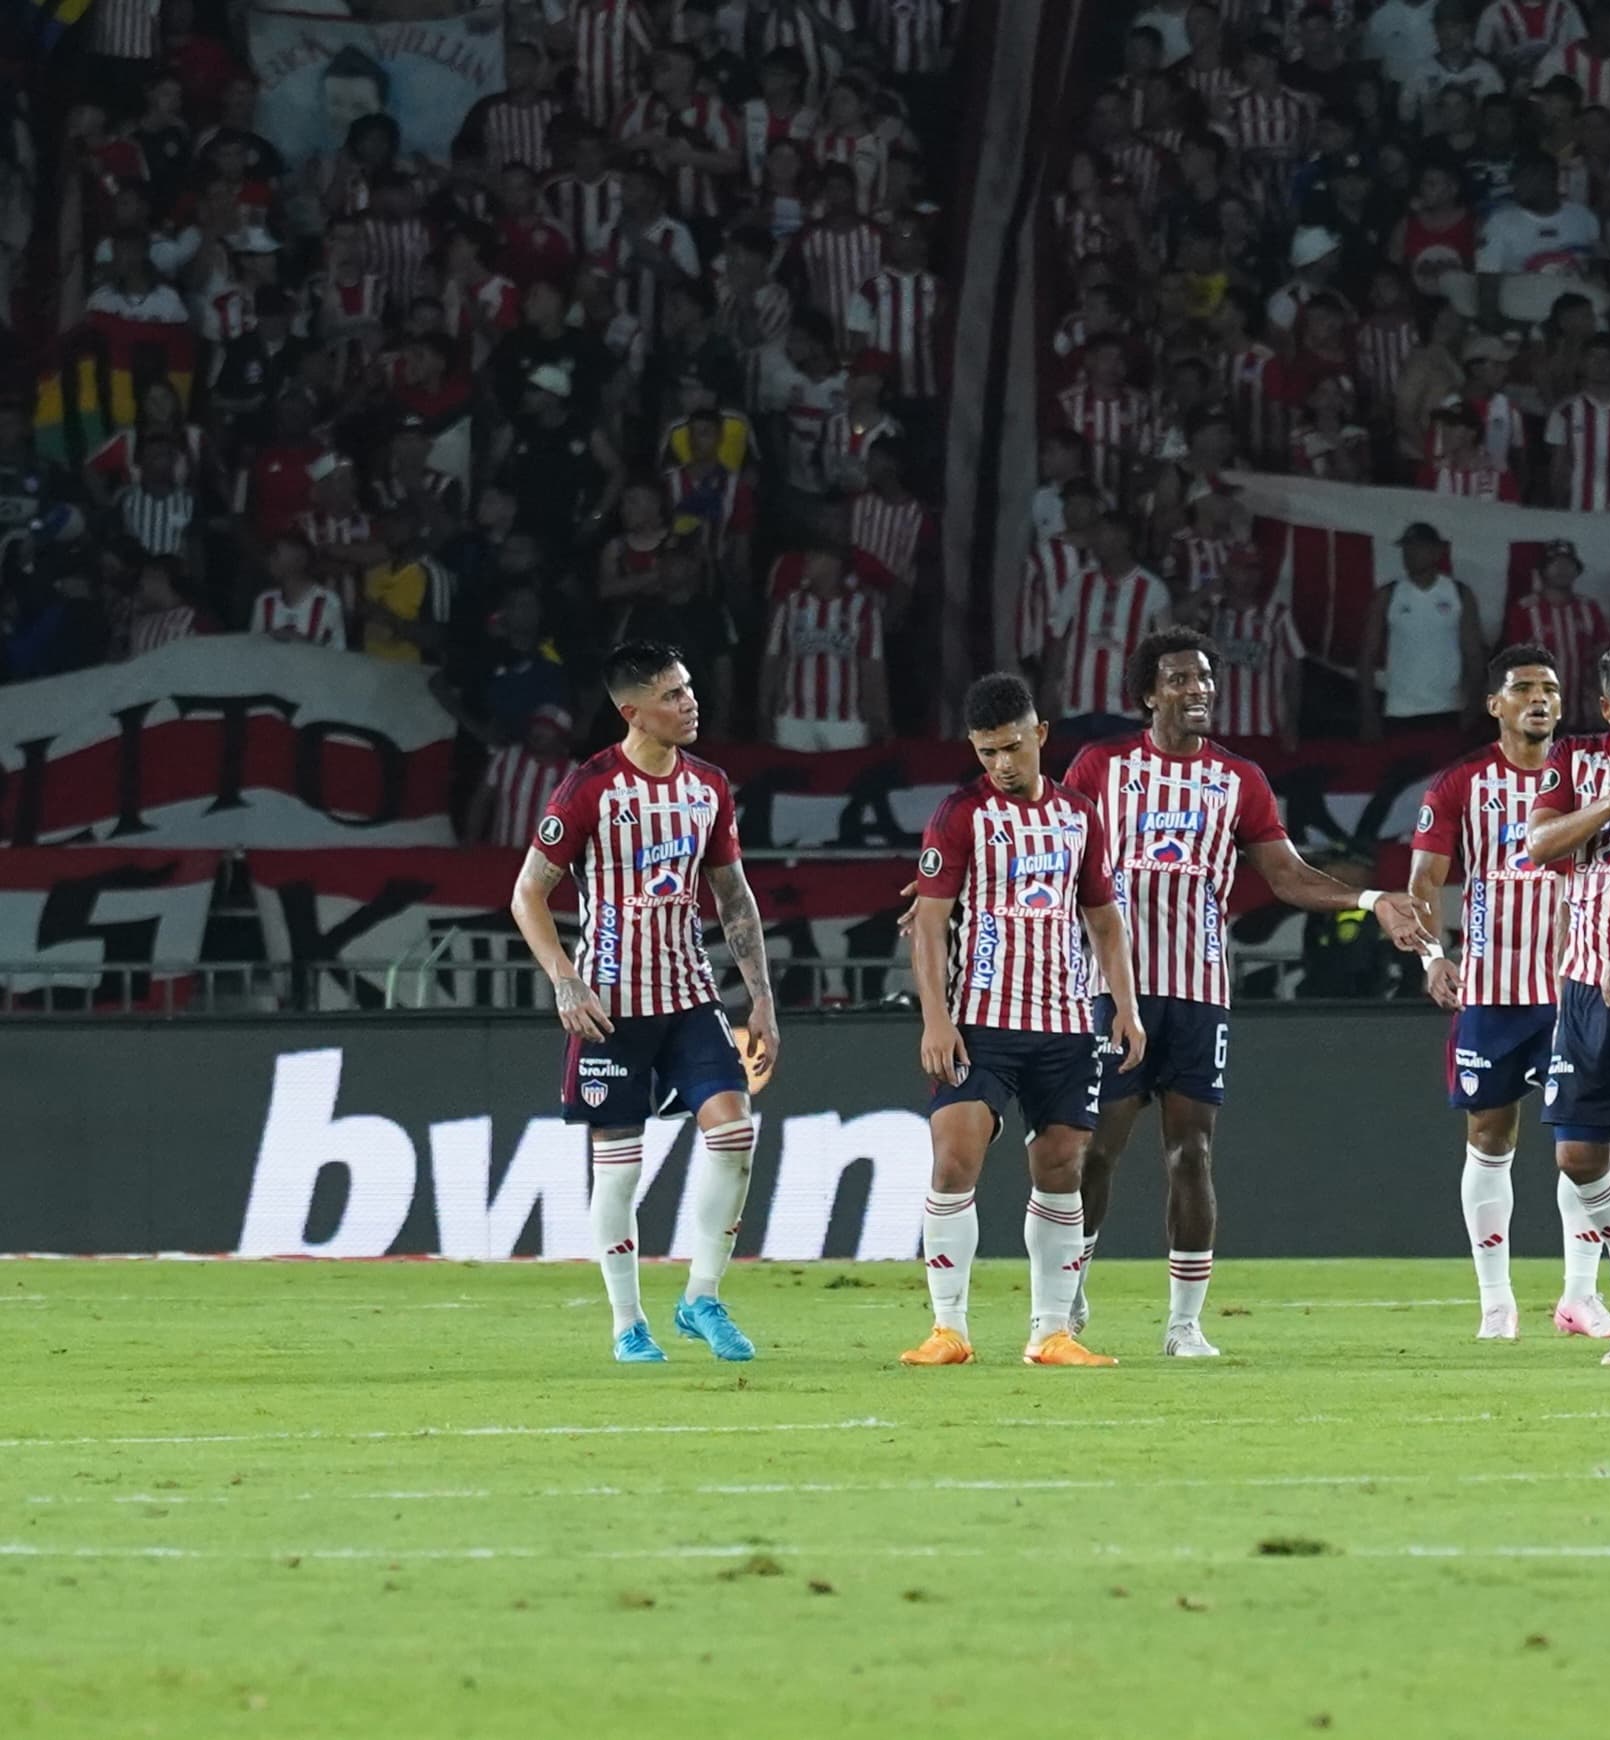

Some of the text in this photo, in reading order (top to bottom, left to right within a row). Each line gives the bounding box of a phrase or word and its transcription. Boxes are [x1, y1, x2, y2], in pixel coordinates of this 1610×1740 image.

[0, 692, 417, 848] LITO
[1144, 813, 1198, 830] AGUILA
[640, 837, 692, 868] AGUILA
[1014, 853, 1064, 877] AGUILA
[1123, 857, 1208, 877] OLIMPICA
[1486, 870, 1557, 881] OLIMPIC
[1214, 1023, 1229, 1069] 6
[579, 1064, 628, 1077] brasilia
